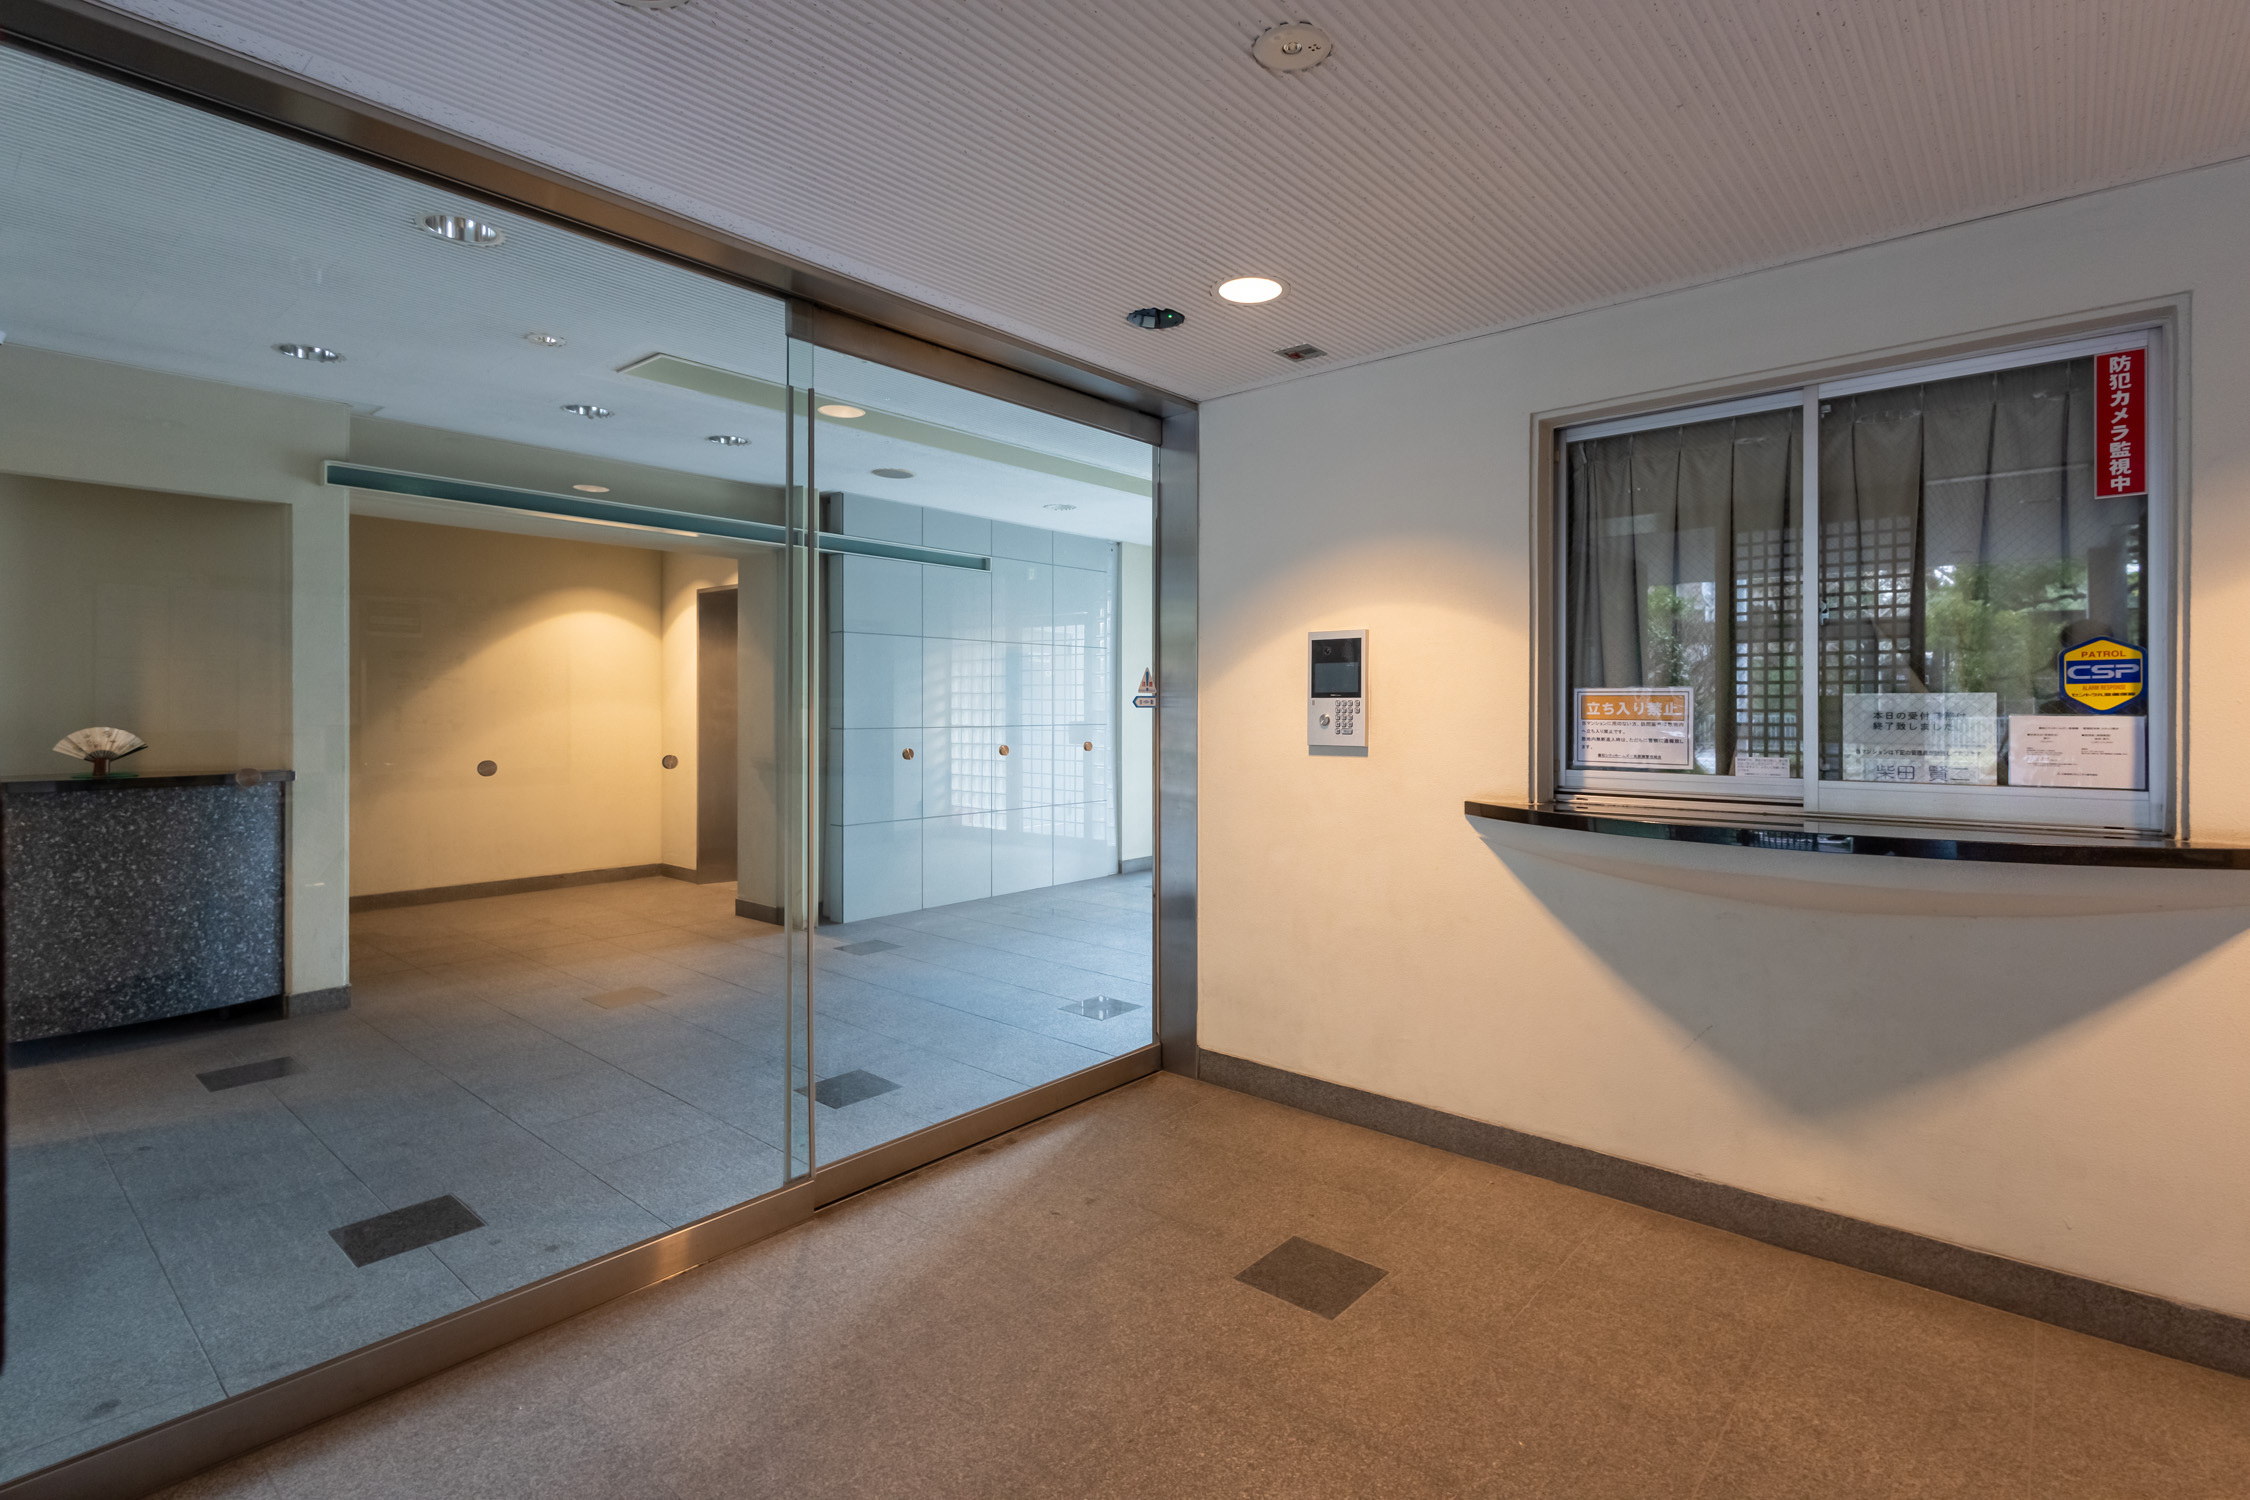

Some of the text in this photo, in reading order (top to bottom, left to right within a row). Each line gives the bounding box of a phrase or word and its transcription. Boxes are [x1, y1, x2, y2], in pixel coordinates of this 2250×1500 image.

[2109, 354, 2132, 493] 防犯カメラ監視中
[2081, 650, 2127, 658] PATROL
[2067, 663, 2140, 680] CSP
[1586, 701, 1683, 716] 立ち入り禁止
[1876, 764, 1971, 782] 柴田 賢二
